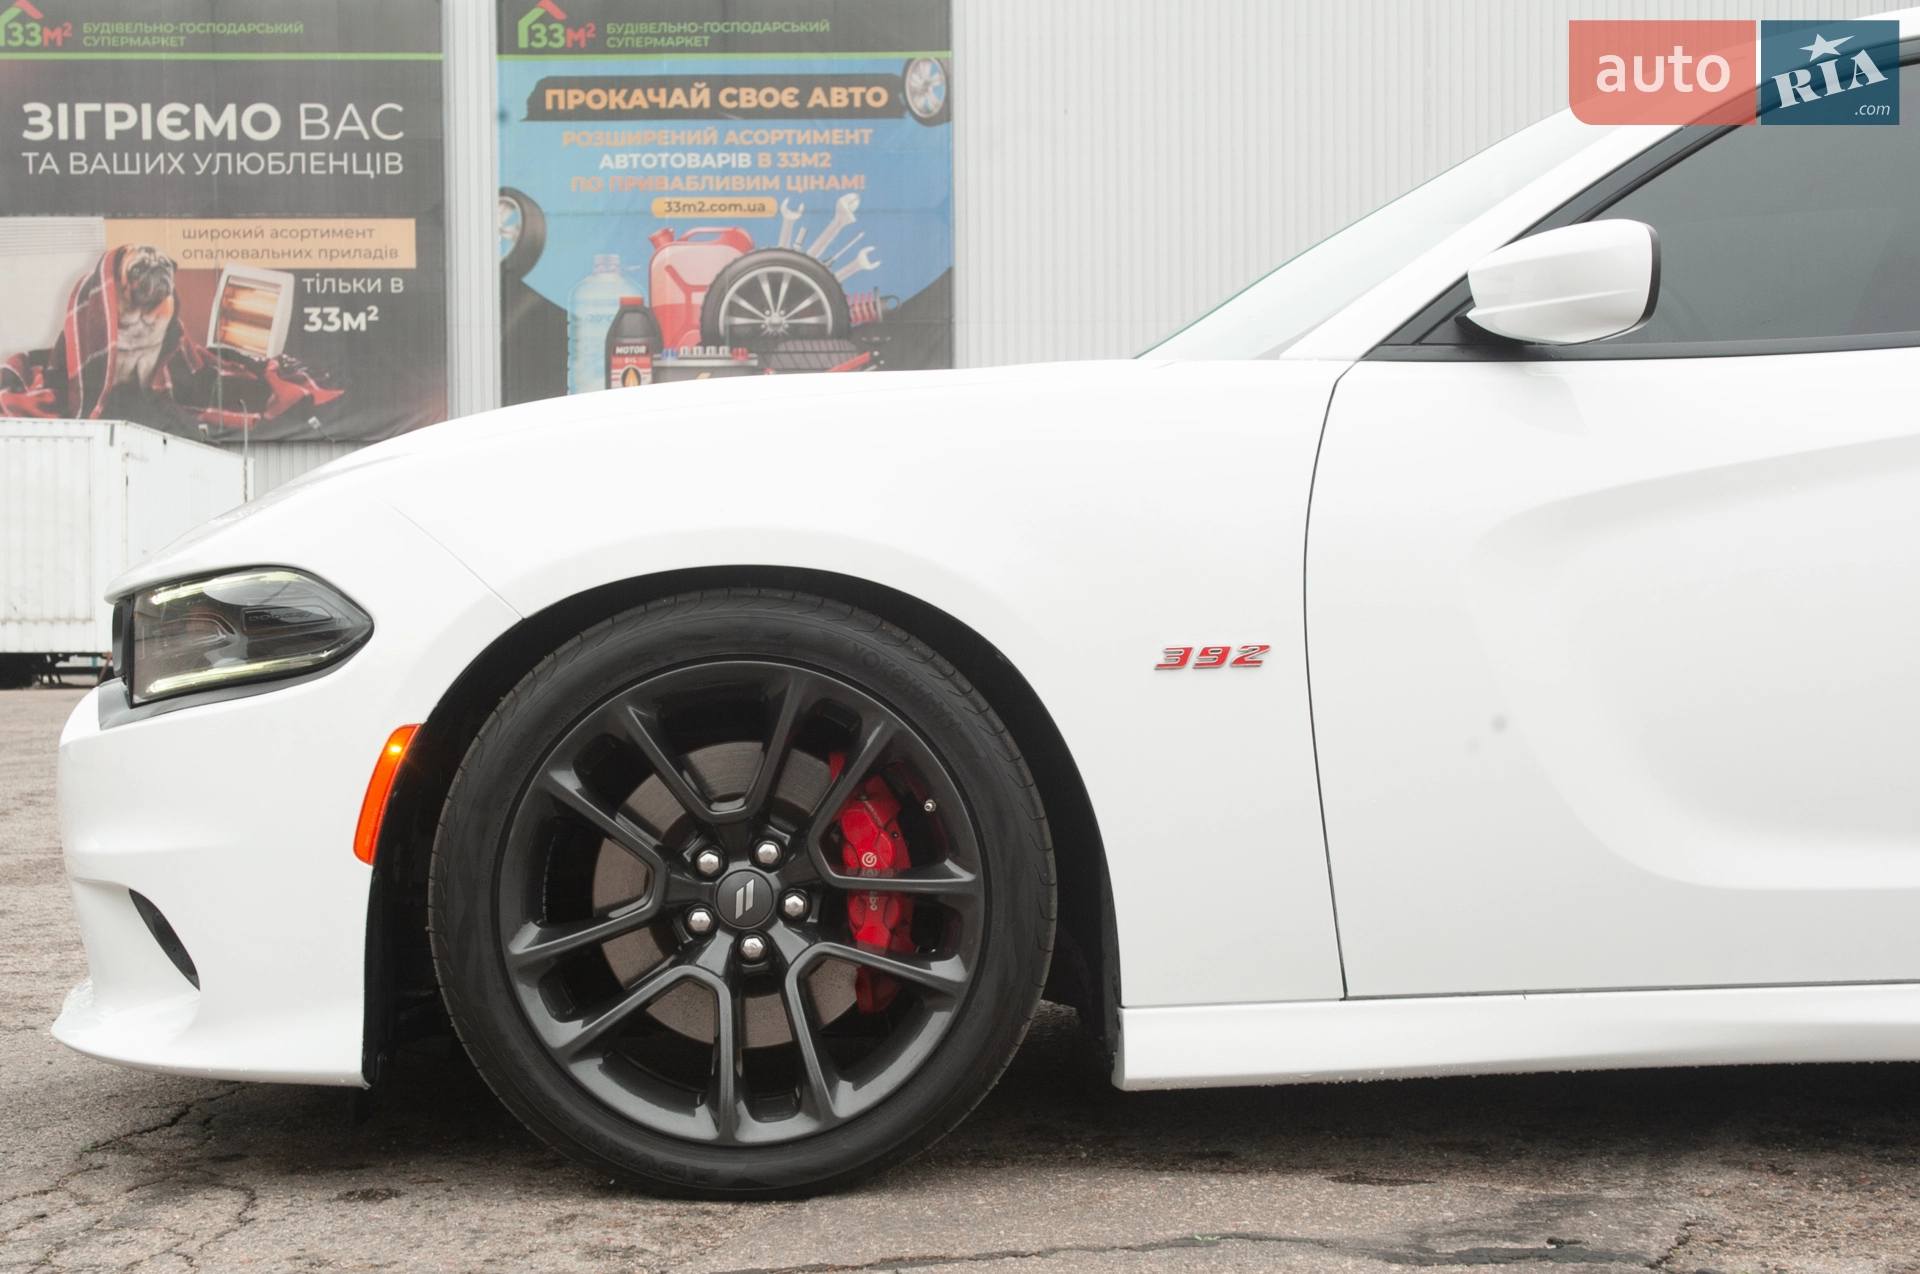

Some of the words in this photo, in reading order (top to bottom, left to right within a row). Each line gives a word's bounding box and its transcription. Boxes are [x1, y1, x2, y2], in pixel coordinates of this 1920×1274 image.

[83, 21, 304, 36] БУДІВЕЛЬНО-ГОСПОДАРСЬКИЙ
[606, 19, 831, 36] БУДІВЕЛЬНО-ГОСПОДАРСЬКИЙ
[83, 35, 187, 48] СУПЕРМАРКЕТ
[606, 35, 711, 48] СУПЕРМАРКЕТ
[545, 83, 711, 110] ПРОКАЧАЙ
[718, 87, 800, 109] СВОЄ
[807, 86, 889, 109] АВТО
[22, 102, 282, 141] ЗІГРІЄМО
[299, 103, 405, 141] ВАС
[562, 127, 718, 147] РОЗШИРЕНИЙ
[724, 128, 873, 147] АСОРТИМЕНТ
[21, 152, 60, 175] ТА
[69, 152, 186, 175] ВАШИХ
[193, 152, 404, 179] УЛЮБЛЕНЦІВ
[598, 152, 752, 170] АВТОТОВАРІВ
[757, 152, 772, 168] В
[571, 176, 604, 193] ПО
[609, 175, 781, 192] ПРИВАБЛИВИМ
[786, 174, 866, 195] ЦІНАМ!
[663, 201, 766, 214] 33m2.com.ua
[182, 226, 266, 242] широкий
[269, 227, 376, 242] асортимент
[182, 247, 313, 261] опалювальних
[318, 244, 399, 261] приладів
[302, 272, 382, 294] тільки
[390, 277, 405, 294] в
[615, 345, 647, 355] MOTOR
[1154, 644, 1271, 671] 392
[846, 639, 966, 739] YOKOHAMA
